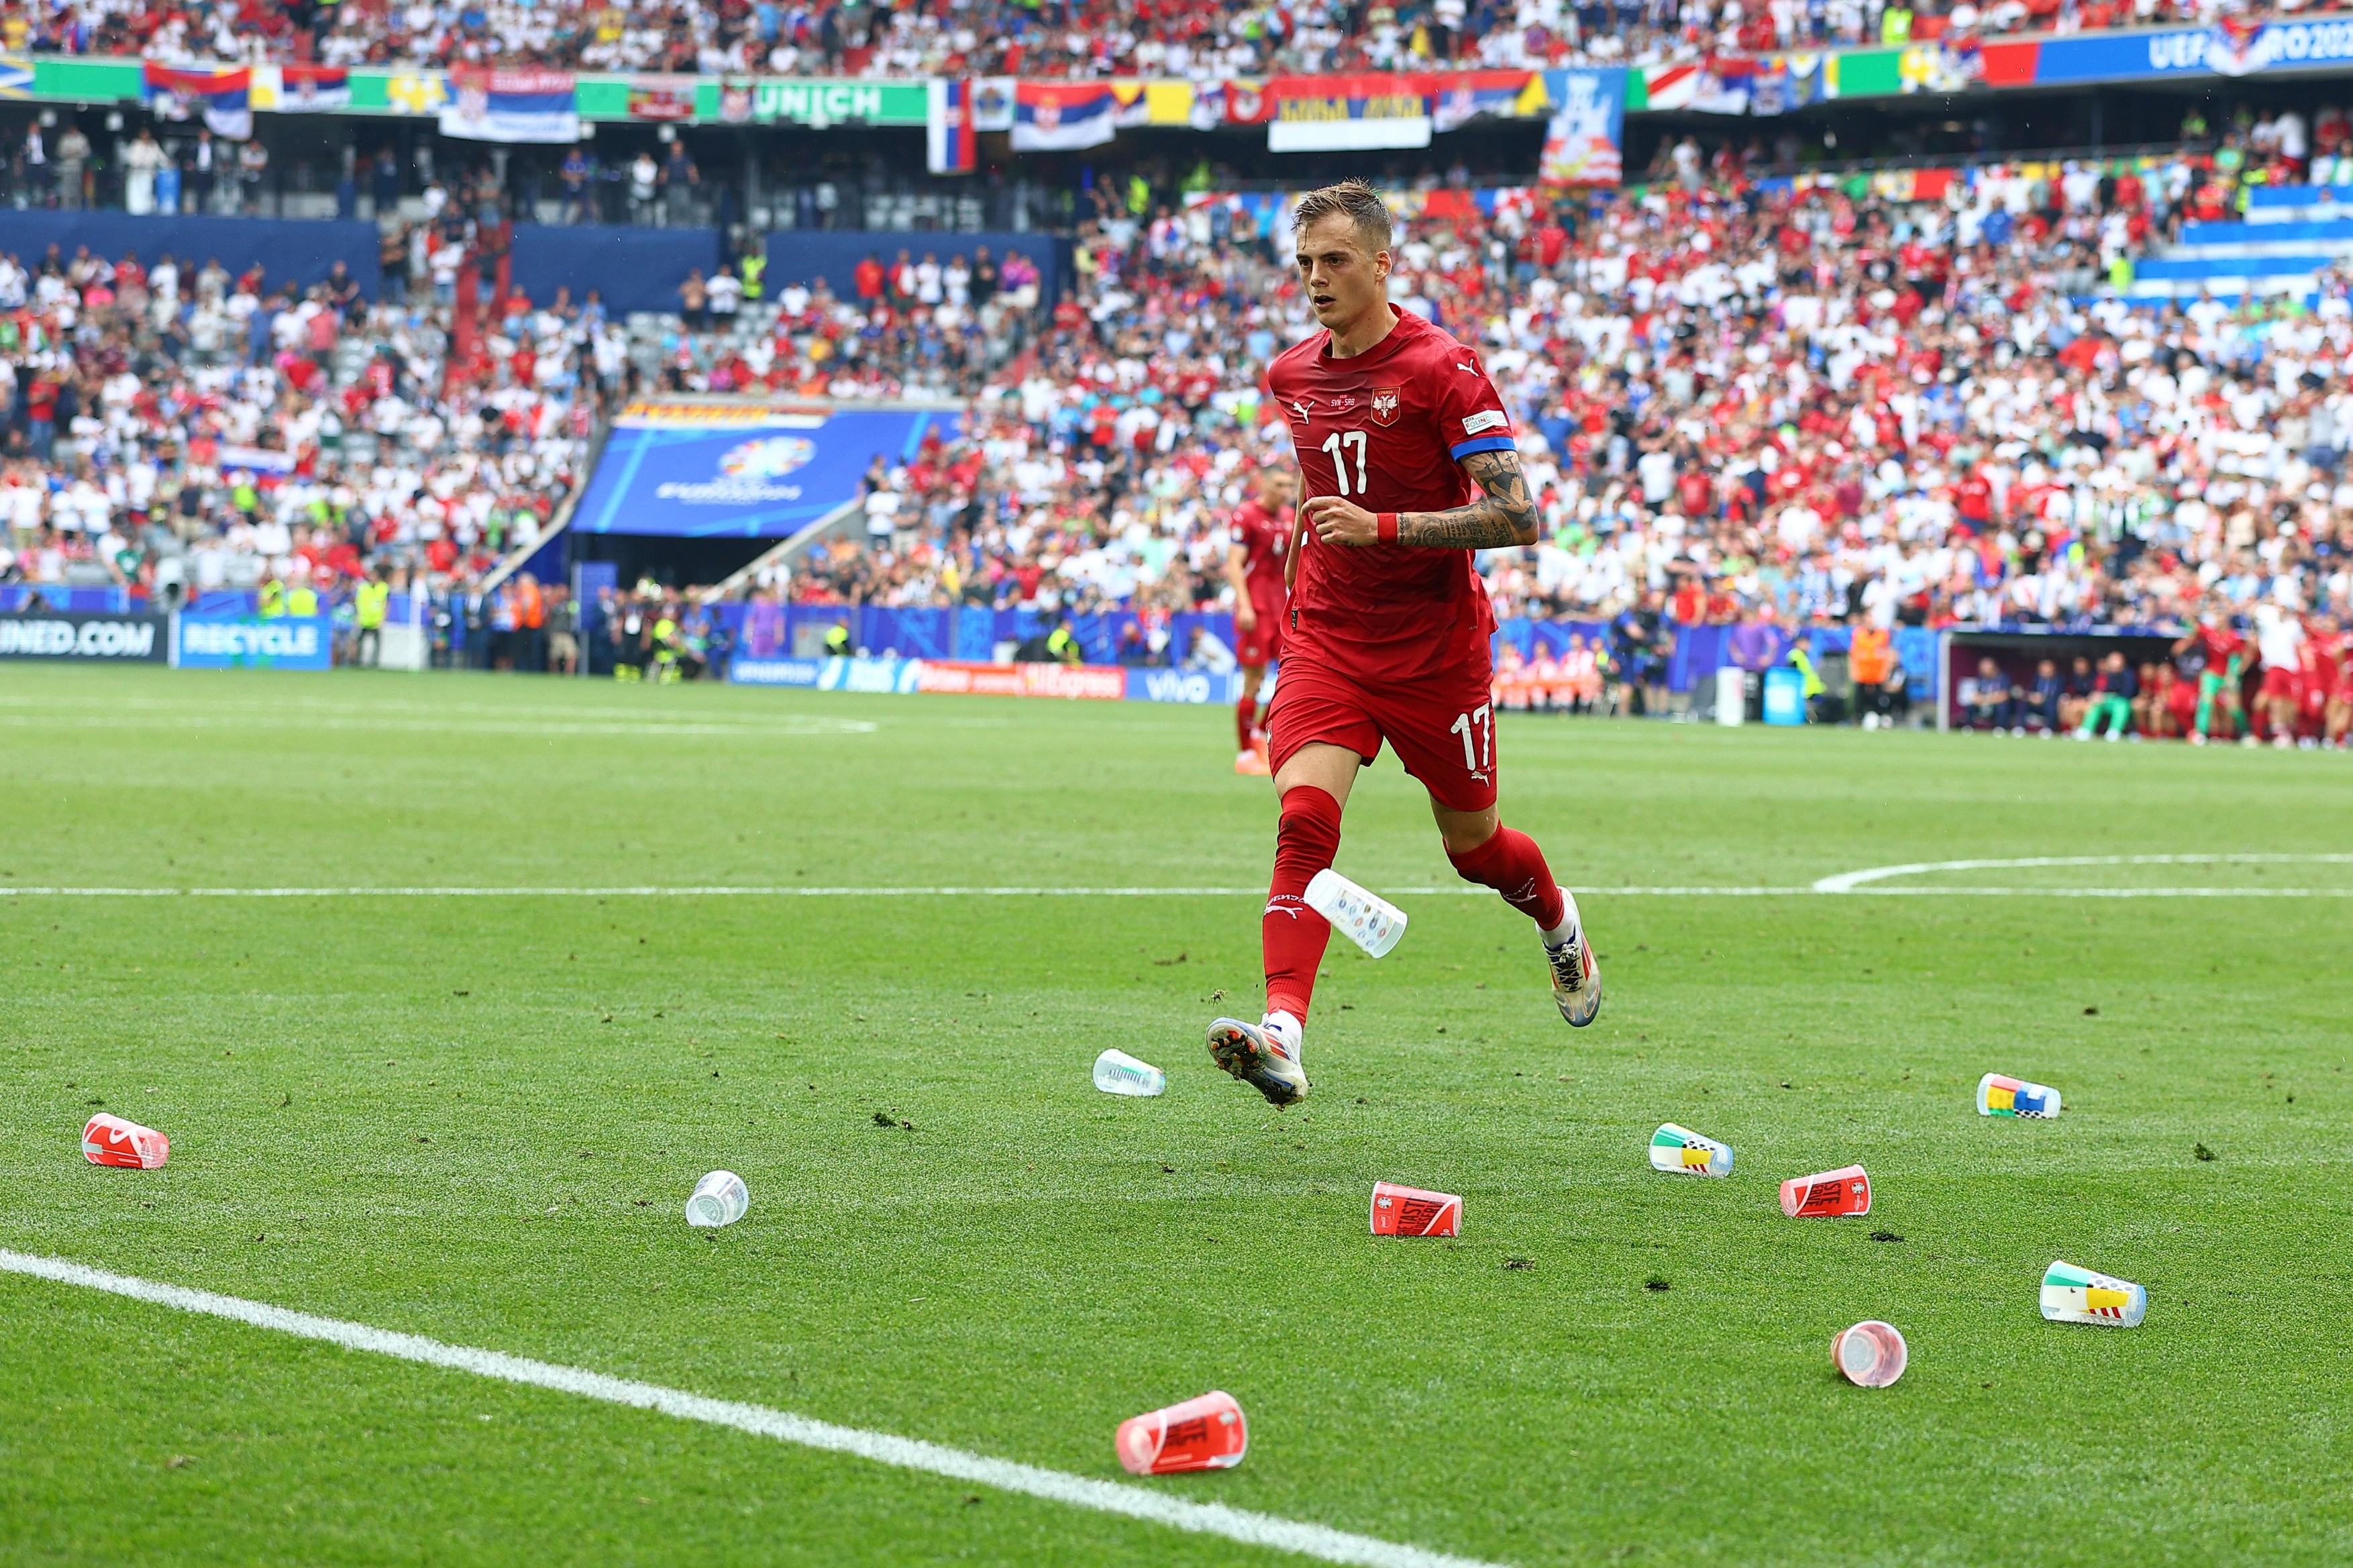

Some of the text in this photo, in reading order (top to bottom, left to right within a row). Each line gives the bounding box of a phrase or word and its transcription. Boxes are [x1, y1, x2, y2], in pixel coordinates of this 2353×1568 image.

[753, 87, 882, 116] UNICH
[1322, 431, 1367, 496] 17
[184, 623, 318, 655] RECYCLE
[1145, 670, 1210, 703] vivo
[1451, 702, 1490, 771] 17
